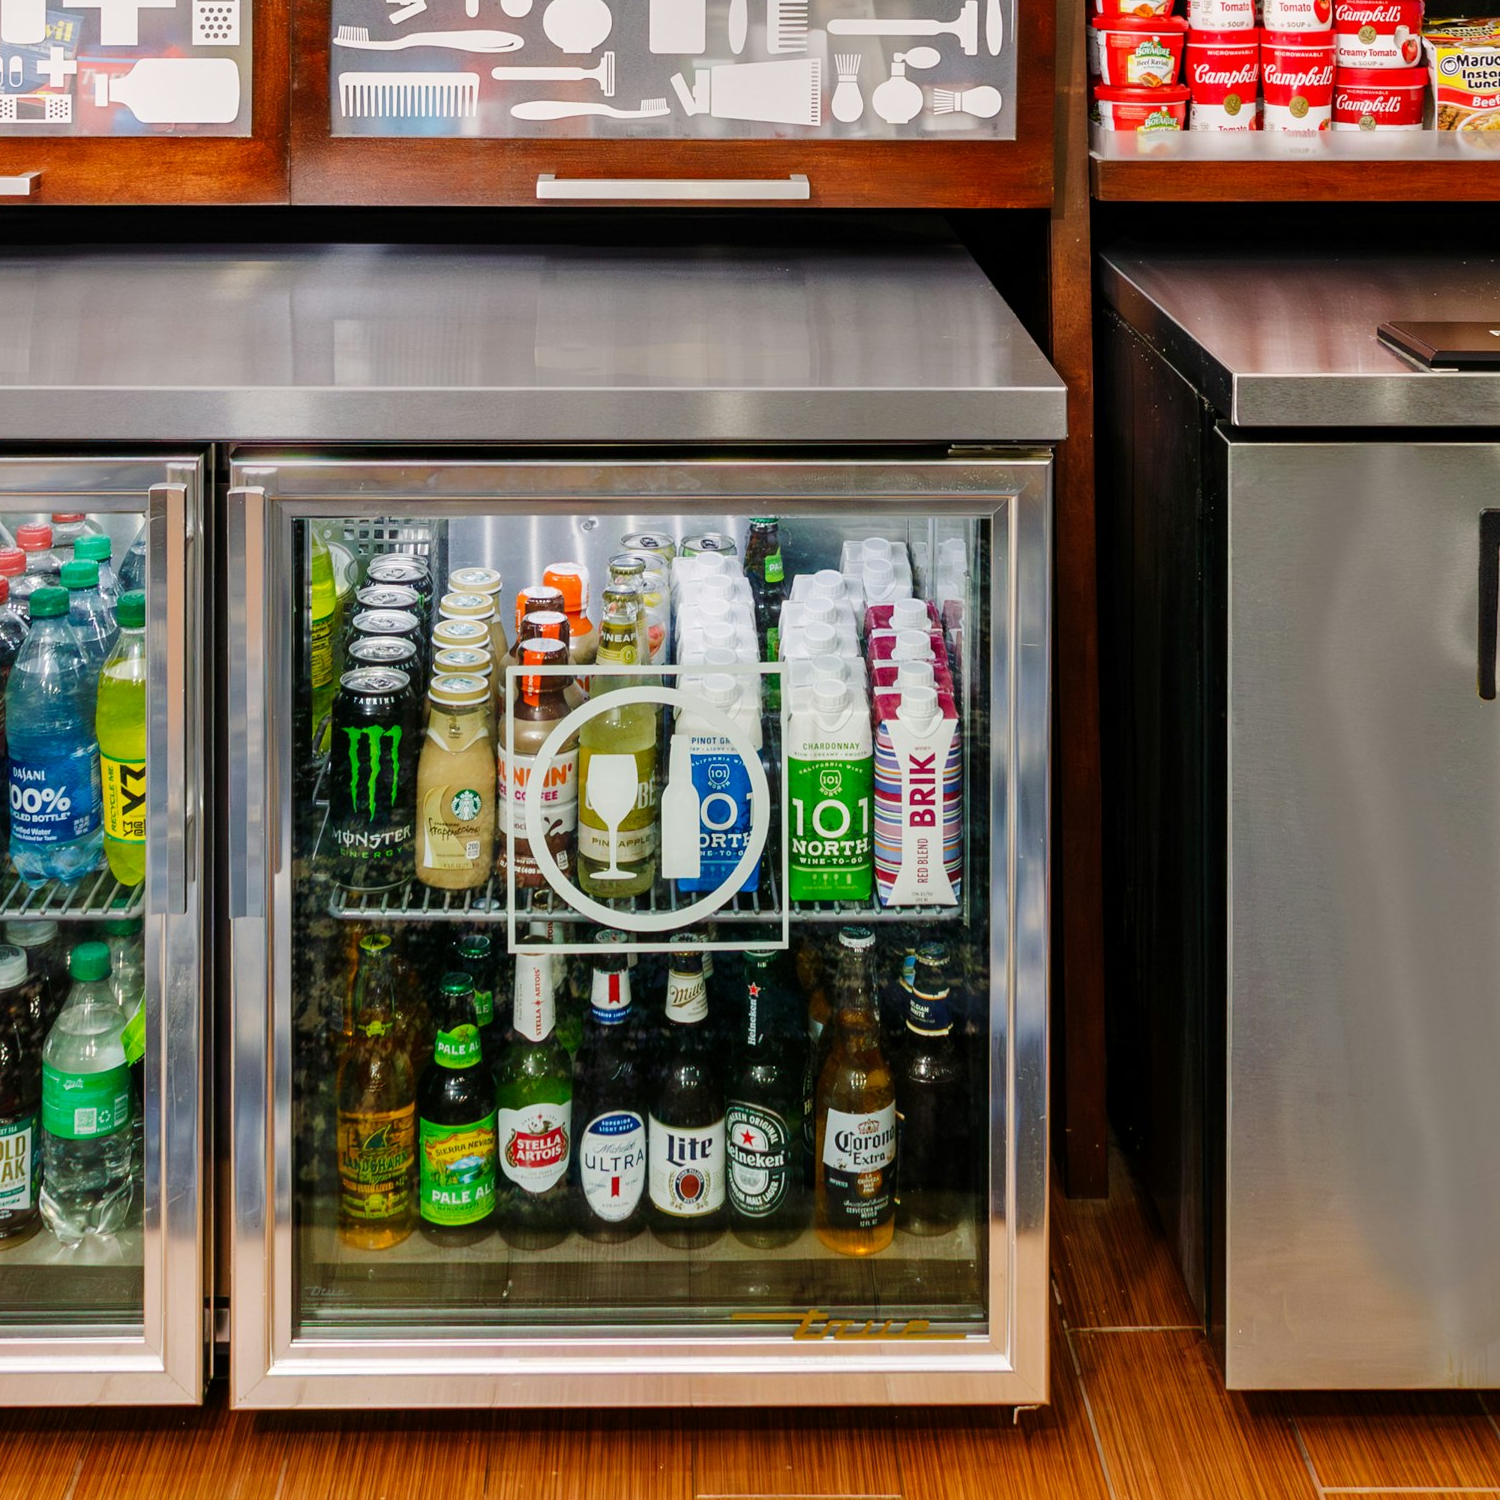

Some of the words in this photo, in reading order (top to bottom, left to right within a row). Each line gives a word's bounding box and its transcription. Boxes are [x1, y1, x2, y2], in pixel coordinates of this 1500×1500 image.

[1279, 2, 1312, 12] Tomato
[1334, 4, 1401, 23] Campbell's
[1263, 63, 1333, 88] Campbell's
[1335, 95, 1401, 114] Campbell's
[803, 742, 860, 750] CHARDONNAY
[13, 767, 46, 782] DASANI
[909, 752, 937, 828] BRIK
[793, 797, 869, 838] 101
[331, 824, 412, 848] MONSTER
[339, 847, 404, 859] ENERGY
[793, 838, 869, 856] NORTH
[917, 838, 929, 864] BLEND
[799, 857, 863, 865] WINE-TO-GO
[916, 866, 929, 884] RED
[748, 999, 757, 1045] Heineken
[516, 1134, 562, 1151] STELLA
[666, 1133, 713, 1165] Lite
[835, 1125, 894, 1156] Corona
[515, 1145, 562, 1161] ARTOIS
[585, 1150, 644, 1173] ULTRA
[853, 1151, 886, 1166] Extra
[731, 1309, 966, 1340] true
